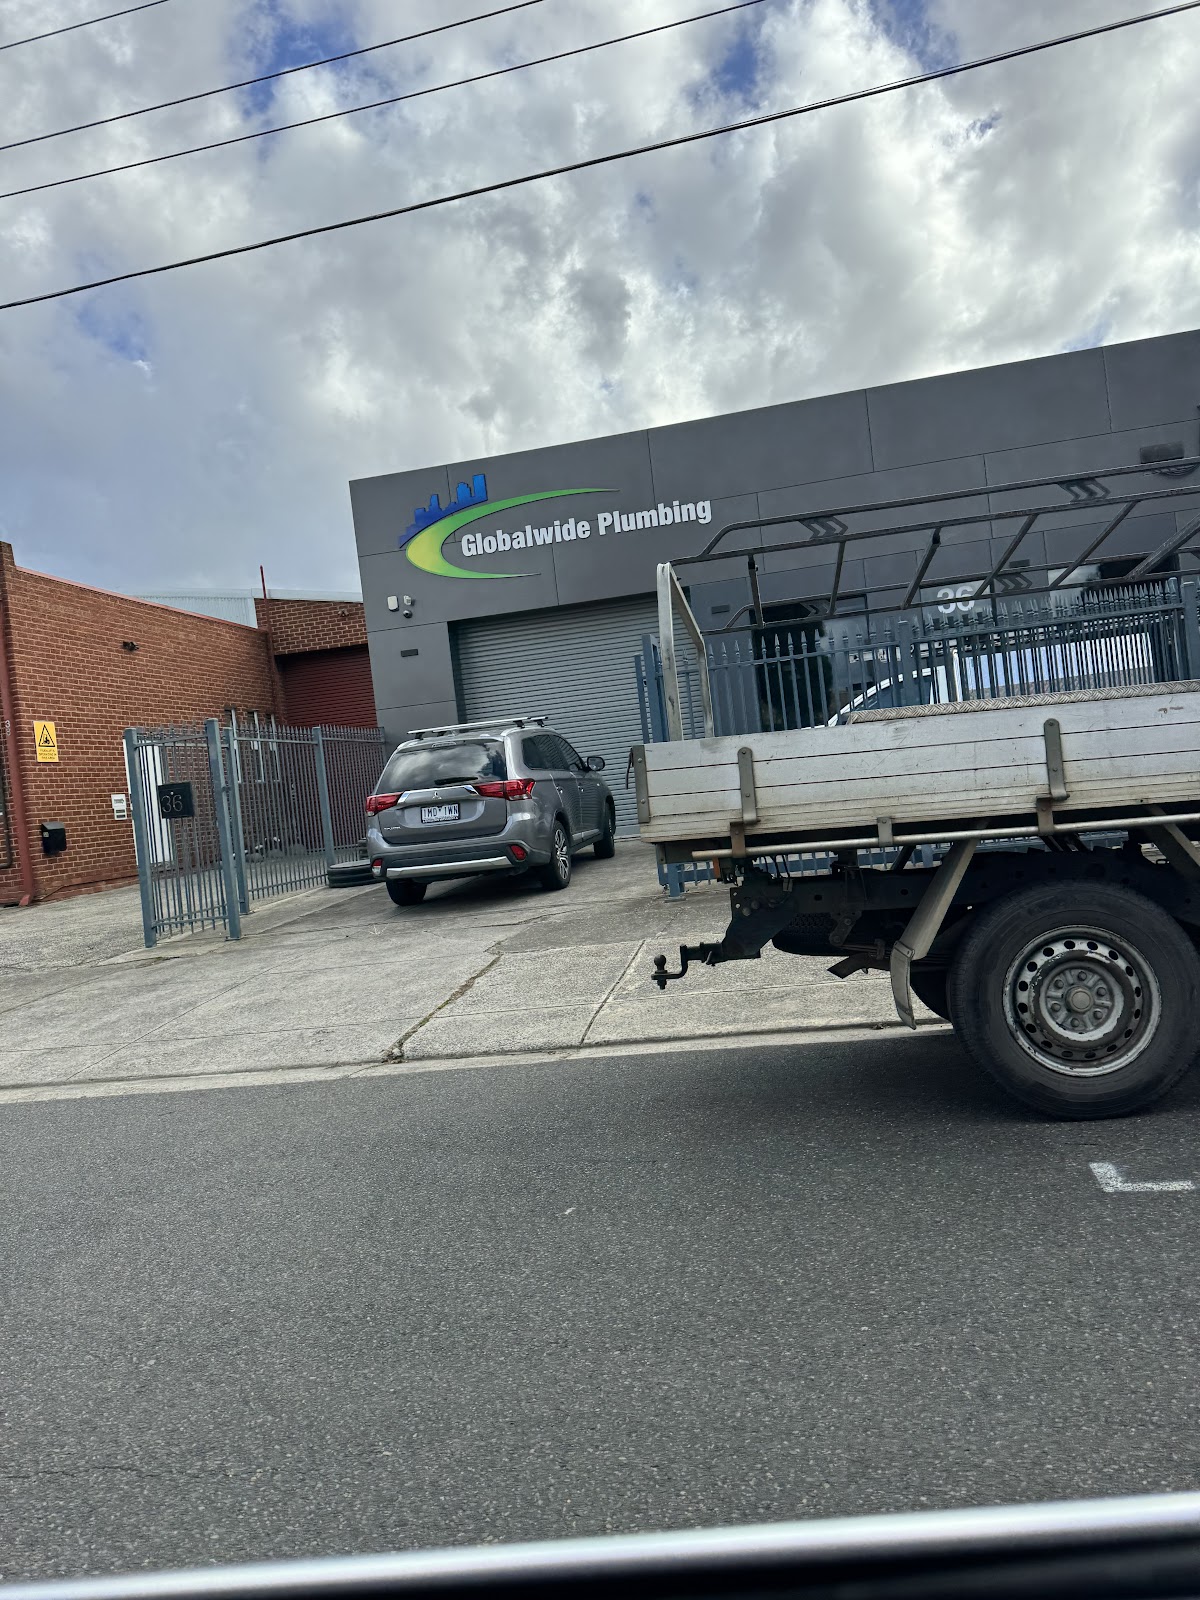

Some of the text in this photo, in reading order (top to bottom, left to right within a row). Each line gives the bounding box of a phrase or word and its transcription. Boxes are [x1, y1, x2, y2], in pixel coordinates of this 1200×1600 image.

[461, 500, 712, 557] Globalwide Plumbing
[936, 585, 975, 613] 36
[161, 794, 183, 813] 36
